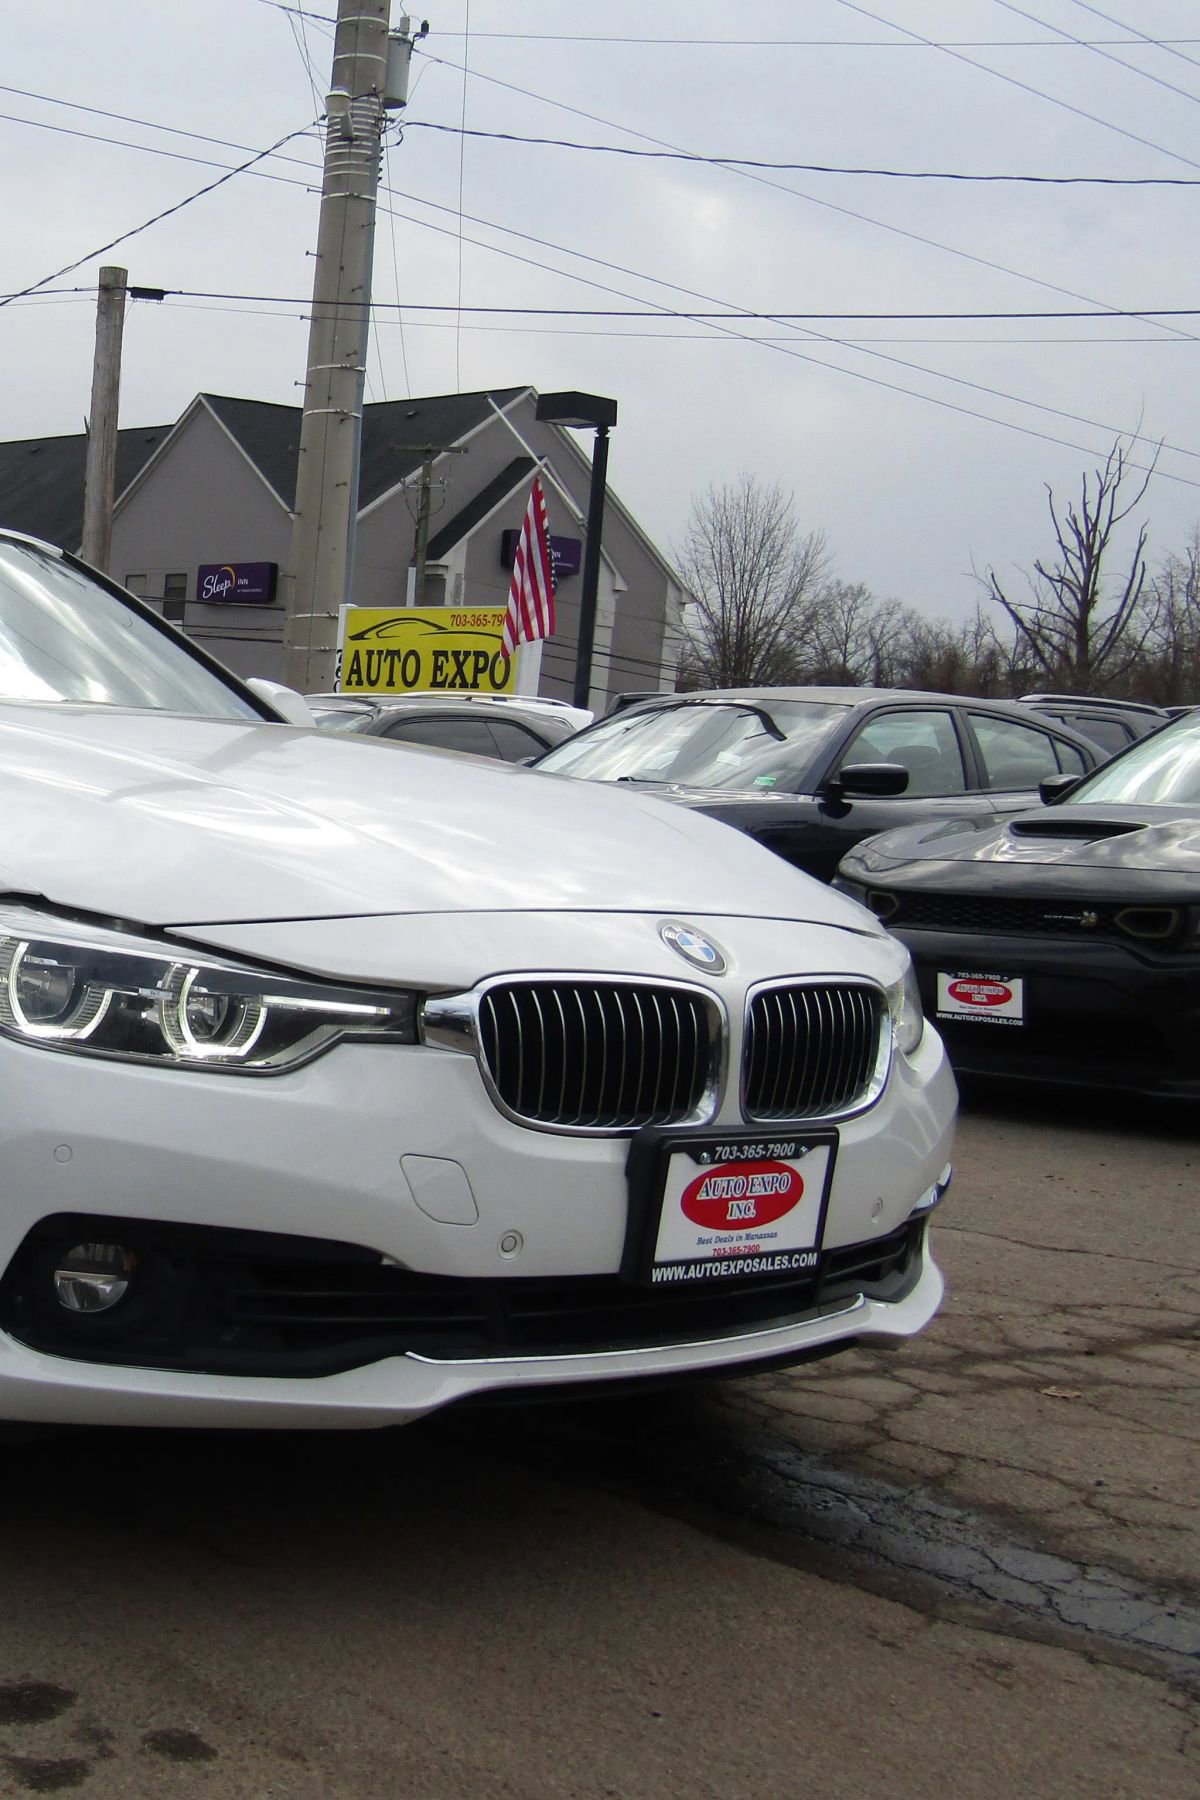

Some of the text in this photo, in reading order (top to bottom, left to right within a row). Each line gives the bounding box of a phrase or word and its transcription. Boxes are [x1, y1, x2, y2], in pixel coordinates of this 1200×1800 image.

[202, 574, 232, 599] Sleep
[345, 649, 511, 690] AUTO EXPO
[936, 1012, 1023, 1026] WWW.AUTOEXPOSALES.COM
[714, 1143, 795, 1161] 703-365-7900
[698, 1173, 791, 1199] AUTO EXPO
[727, 1201, 756, 1220] INC.
[696, 1236, 713, 1245] Best
[714, 1234, 734, 1244] Deals
[735, 1233, 743, 1242] in
[712, 1244, 760, 1257] 703-365-7900
[651, 1252, 818, 1283] WWW.AUTOEXPOSALES.COM
